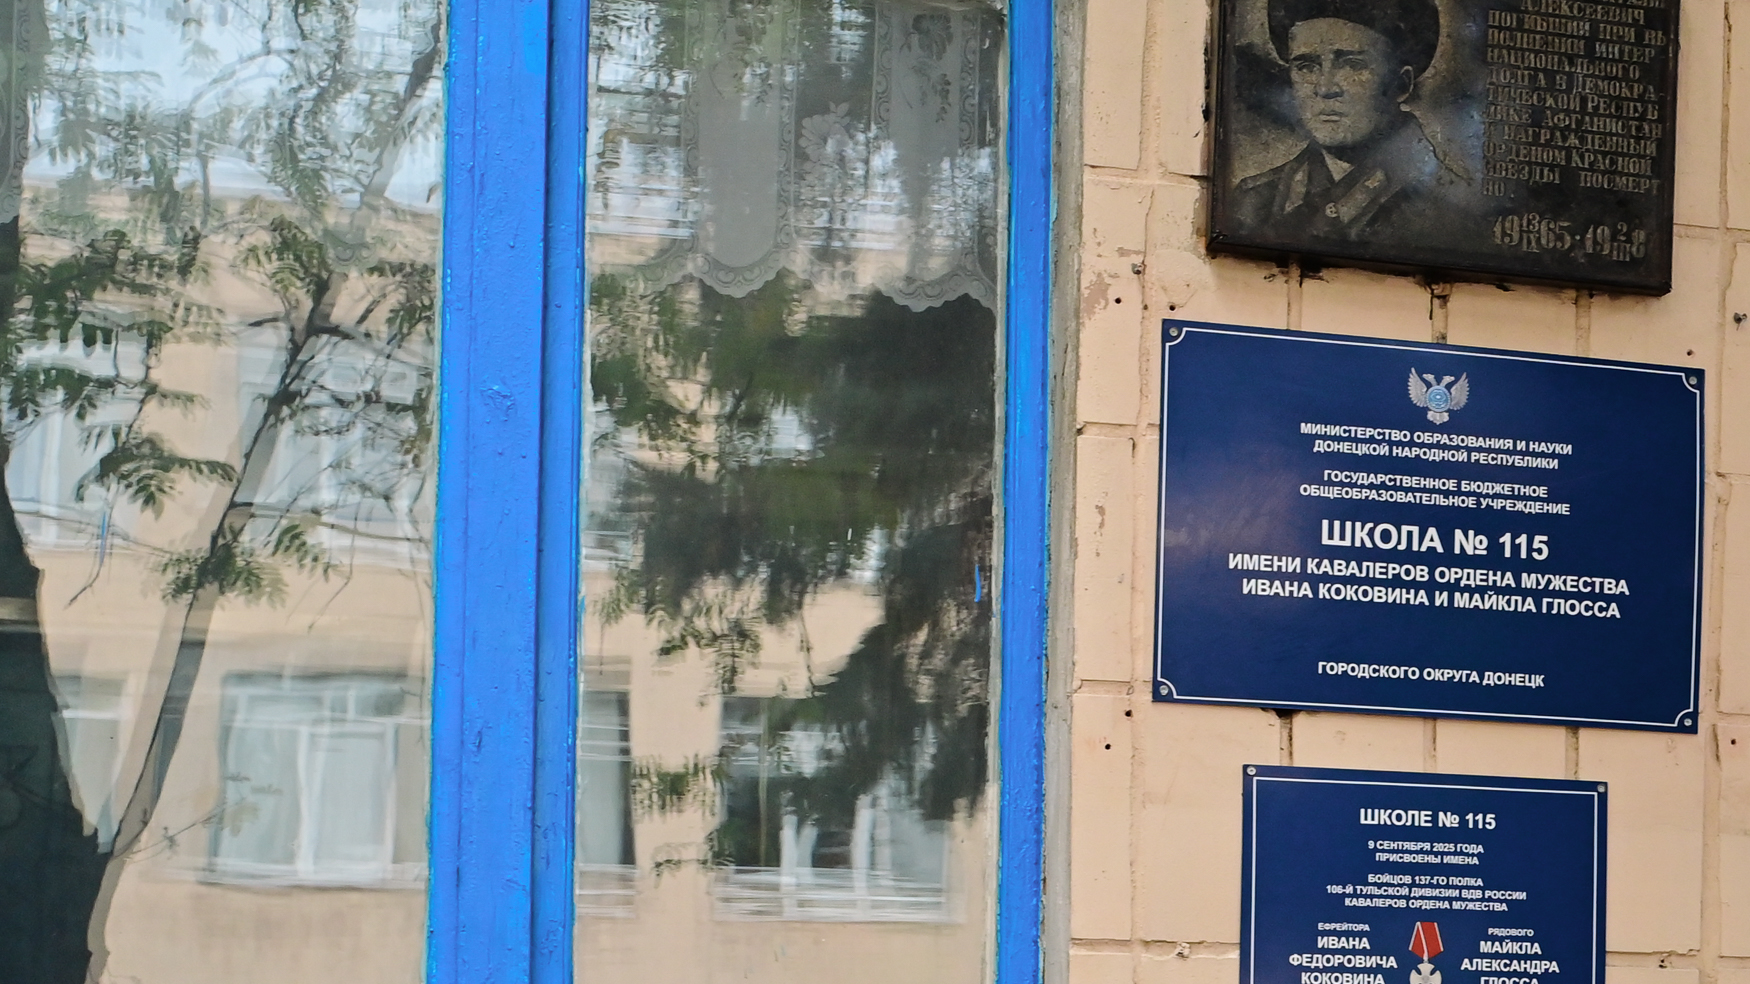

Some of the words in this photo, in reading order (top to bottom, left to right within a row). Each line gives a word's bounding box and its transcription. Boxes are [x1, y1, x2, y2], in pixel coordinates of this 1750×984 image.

[1599, 23, 1635, 42] ПРИ
[1487, 47, 1640, 80] НАЦИОНАЛЬНОГО
[1556, 74, 1566, 89] В
[1587, 94, 1658, 120] РЕСПУБ
[1543, 109, 1662, 138] АФГАНИСТАН
[1571, 148, 1652, 176] КРАСНОЙ
[1300, 422, 1411, 442] МИНИСТЕРСТВО
[1413, 431, 1514, 450] ОБРАЗОВАНИЯ
[1516, 439, 1526, 452] И
[1529, 441, 1572, 455] НАУКИ
[1312, 439, 1390, 456] ДОНЕЦКОЙ
[1392, 445, 1468, 463] НАРОДНОЙ
[1470, 451, 1559, 470] РЕСПУБЛИКИ
[1323, 469, 1458, 491] ГОСУДАРСТВЕННОЕ
[1460, 480, 1548, 498] БЮДЖЕТНОЕ
[1299, 483, 1477, 508] ОБЩЕОБРАЗОВАТЕЛЬНОЕ
[1479, 497, 1571, 515] УЧРЕЖДЕНИЕ
[1321, 519, 1444, 553] ШКОЛА
[1453, 528, 1489, 556] №
[1499, 532, 1549, 561] 115
[1228, 552, 1301, 574] ИМЕНИ
[1306, 557, 1430, 582] КАВАЛЕРОВ
[1434, 566, 1516, 588] ОРДЕНА
[1521, 572, 1630, 596] МУЖЕСТВА
[1242, 577, 1314, 599] ИВАНА
[1318, 582, 1430, 606] КОКОВИНА
[1434, 590, 1449, 607] И
[1453, 590, 1537, 613] МАЙКЛА
[1542, 597, 1621, 619] ГЛОССА
[1317, 661, 1420, 680] ГОРОДСКОГО
[1422, 667, 1481, 684] ОКРУГА
[1482, 671, 1545, 688] ДОНЕЦК
[1360, 808, 1433, 827] ШКОЛЕ
[1438, 811, 1460, 828] №
[1465, 812, 1496, 830] 115
[1367, 840, 1375, 849] 9
[1376, 840, 1431, 851] СЕНТЯБРЯ
[1432, 842, 1456, 852] 2025
[1456, 843, 1484, 855] ГОДА
[1375, 852, 1441, 864] ПРИСВОЕНЫ
[1443, 855, 1480, 865] ИМЕНА
[1368, 873, 1413, 885] БОЙЦОВ
[1414, 875, 1448, 885] 137-ГО
[1448, 876, 1484, 887] ПОЛКА
[1326, 883, 1354, 894] 106-Й
[1355, 885, 1409, 896] ТУЛЬСКОЙ
[1410, 887, 1460, 898] ДИВИЗИИ
[1461, 889, 1483, 900] ВДВ
[1484, 890, 1527, 900] РОССИИ
[1344, 897, 1407, 908] КАВАЛЕРОВ
[1408, 899, 1451, 910] ОРДЕНА
[1452, 900, 1508, 912] МУЖЕСТВА
[1317, 922, 1371, 932] ЕФРЕЙТОРА
[1487, 927, 1534, 937] РЯДОВОГО
[1317, 936, 1371, 950] ИВАНА
[1479, 939, 1542, 955] МАЙКЛА
[1288, 953, 1398, 969] ФЕДОРОВИЧА
[1460, 958, 1560, 975] АЛЕКСАНДРА
